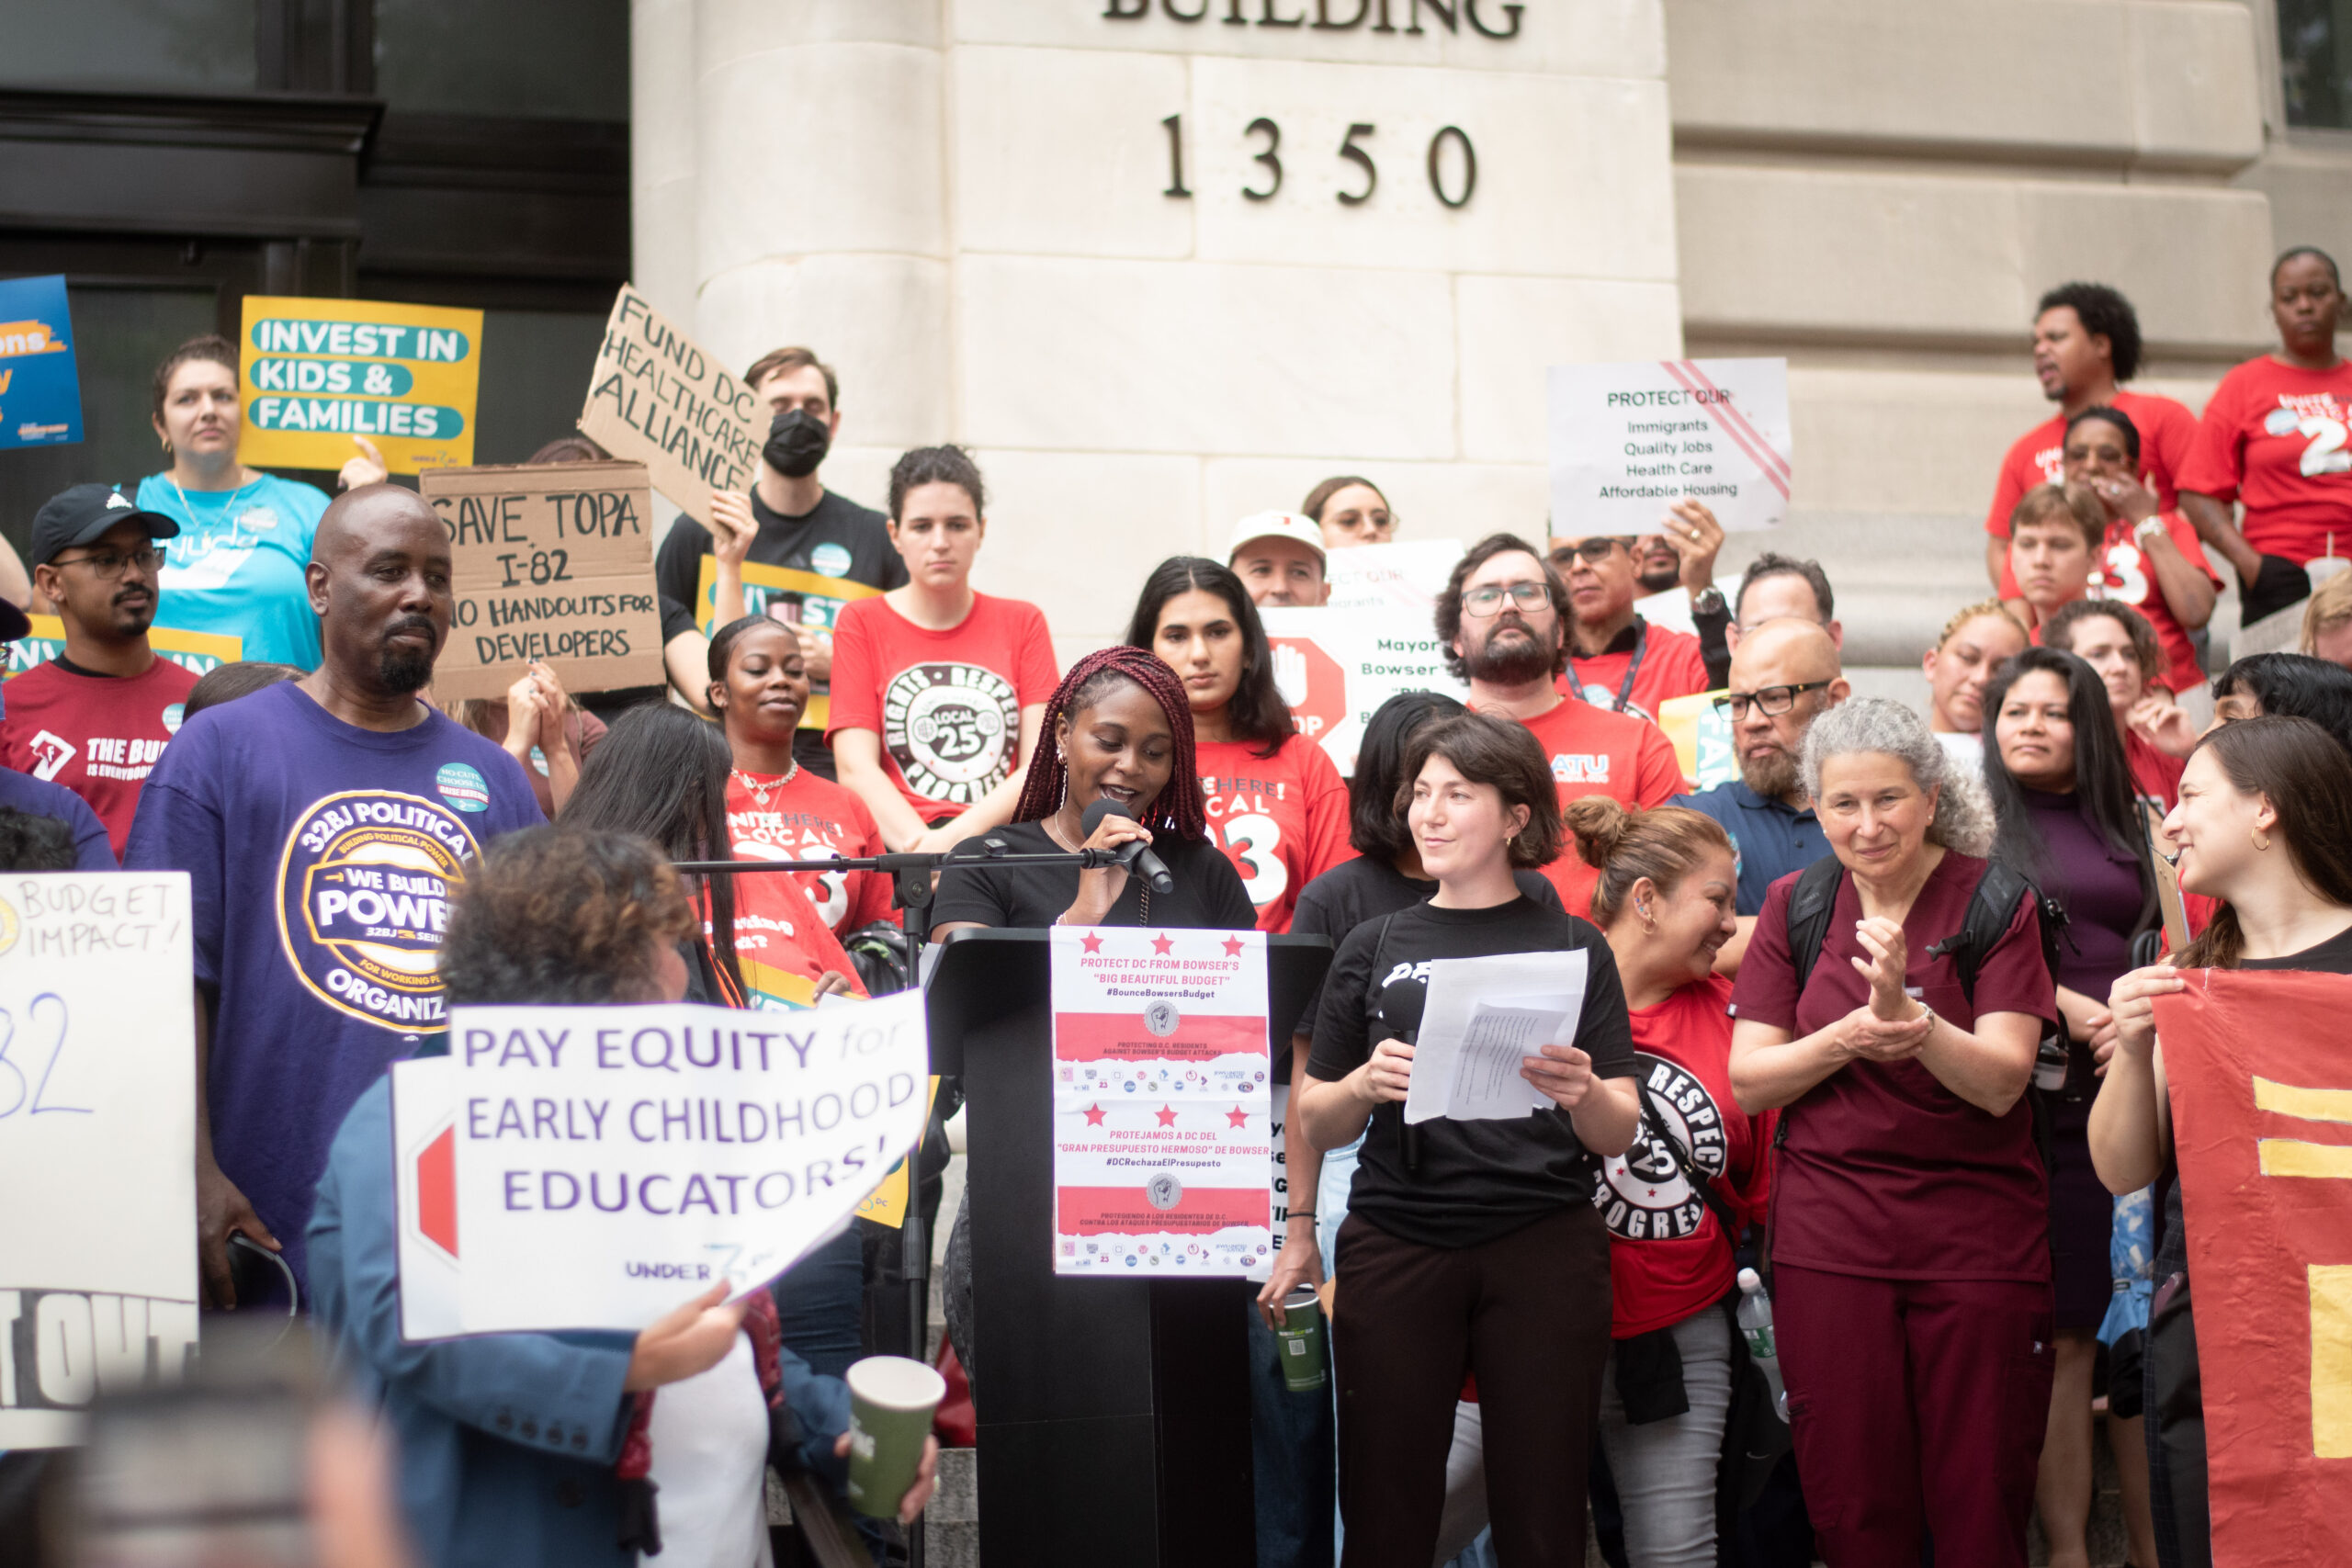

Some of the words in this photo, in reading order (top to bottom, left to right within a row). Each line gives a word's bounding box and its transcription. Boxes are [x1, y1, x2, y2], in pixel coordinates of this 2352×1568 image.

[261, 321, 407, 357] INVEST
[416, 329, 458, 361] IN
[619, 294, 705, 381] FUND
[713, 372, 754, 423] DC
[259, 359, 351, 393] KIDS
[363, 364, 392, 395] &
[603, 329, 761, 472] HEALTHCARE
[1607, 390, 1691, 407] PROTECT
[1695, 389, 1731, 404] OUR
[258, 398, 438, 436] FAMILIES
[1627, 420, 1709, 435] Immigrants
[594, 373, 745, 491] ALLIANCE
[1624, 442, 1677, 457] Quality
[1682, 440, 1713, 454] Jobs
[2297, 415, 2352, 478] 2
[1626, 462, 1676, 478] Health
[1680, 461, 1713, 475] Care
[1599, 484, 1679, 499] Affordable
[1683, 482, 1738, 498] Housing
[546, 493, 640, 538] TOPA
[496, 549, 572, 588] I-82
[489, 595, 616, 626] HANDOUTS
[620, 594, 655, 614] FOR
[476, 629, 630, 665] DEVELOPERS
[1377, 639, 1440, 653] Mayor
[885, 669, 932, 747] RIGHTS
[951, 667, 1020, 741] RESPECT
[933, 709, 975, 725] LOCAL
[1290, 716, 1325, 735] OP
[87, 738, 127, 764] THE
[937, 724, 981, 757] 25
[86, 763, 97, 777] IS
[1550, 754, 1610, 773] ATU
[1205, 794, 1270, 818] CAL
[300, 805, 354, 852] 32BJ
[352, 801, 473, 865] POLITICAL
[733, 828, 836, 848] LOCAL
[338, 833, 374, 854] BUILDING
[374, 832, 419, 846] POLITICAL
[420, 840, 449, 868] POWER
[1204, 814, 1288, 906] 3
[345, 868, 384, 890] WE
[387, 873, 446, 897] BUILD
[18, 880, 173, 919] BUDGET
[29, 919, 182, 958] IMPACT!
[367, 927, 398, 938] 32BJ
[417, 931, 443, 943] SEIU
[359, 959, 380, 975] FOR
[380, 966, 430, 985] WORKING
[1080, 958, 1130, 970] PROTECT
[1132, 958, 1147, 969] DC
[1149, 959, 1181, 970] FROM
[1182, 960, 1239, 971] BOWSER'S
[1120, 974, 1179, 985] BEAUTIFUL
[1107, 988, 1215, 999] #BounceBowsersBudget
[464, 1028, 571, 1068] PAY
[596, 1026, 817, 1072] EQUITY
[839, 1017, 909, 1060] for
[467, 1098, 609, 1141] EARLY
[629, 1072, 915, 1144] CHILDHOOD
[1057, 1143, 1088, 1153] "GRAN
[1091, 1144, 1159, 1154] PRESUPUESTO
[1161, 1145, 1213, 1154] HERMOSO"
[1215, 1145, 1227, 1155] DE
[1228, 1146, 1269, 1156] BOWSER
[1110, 1131, 1174, 1141] PROTEJAMOS
[1176, 1132, 1182, 1140] A
[1184, 1132, 1198, 1140] DC
[1200, 1132, 1217, 1141] DEL
[503, 1134, 886, 1215] EDUCATORS!
[876, 1197, 888, 1207] DC
[626, 1261, 711, 1280] UNDER
